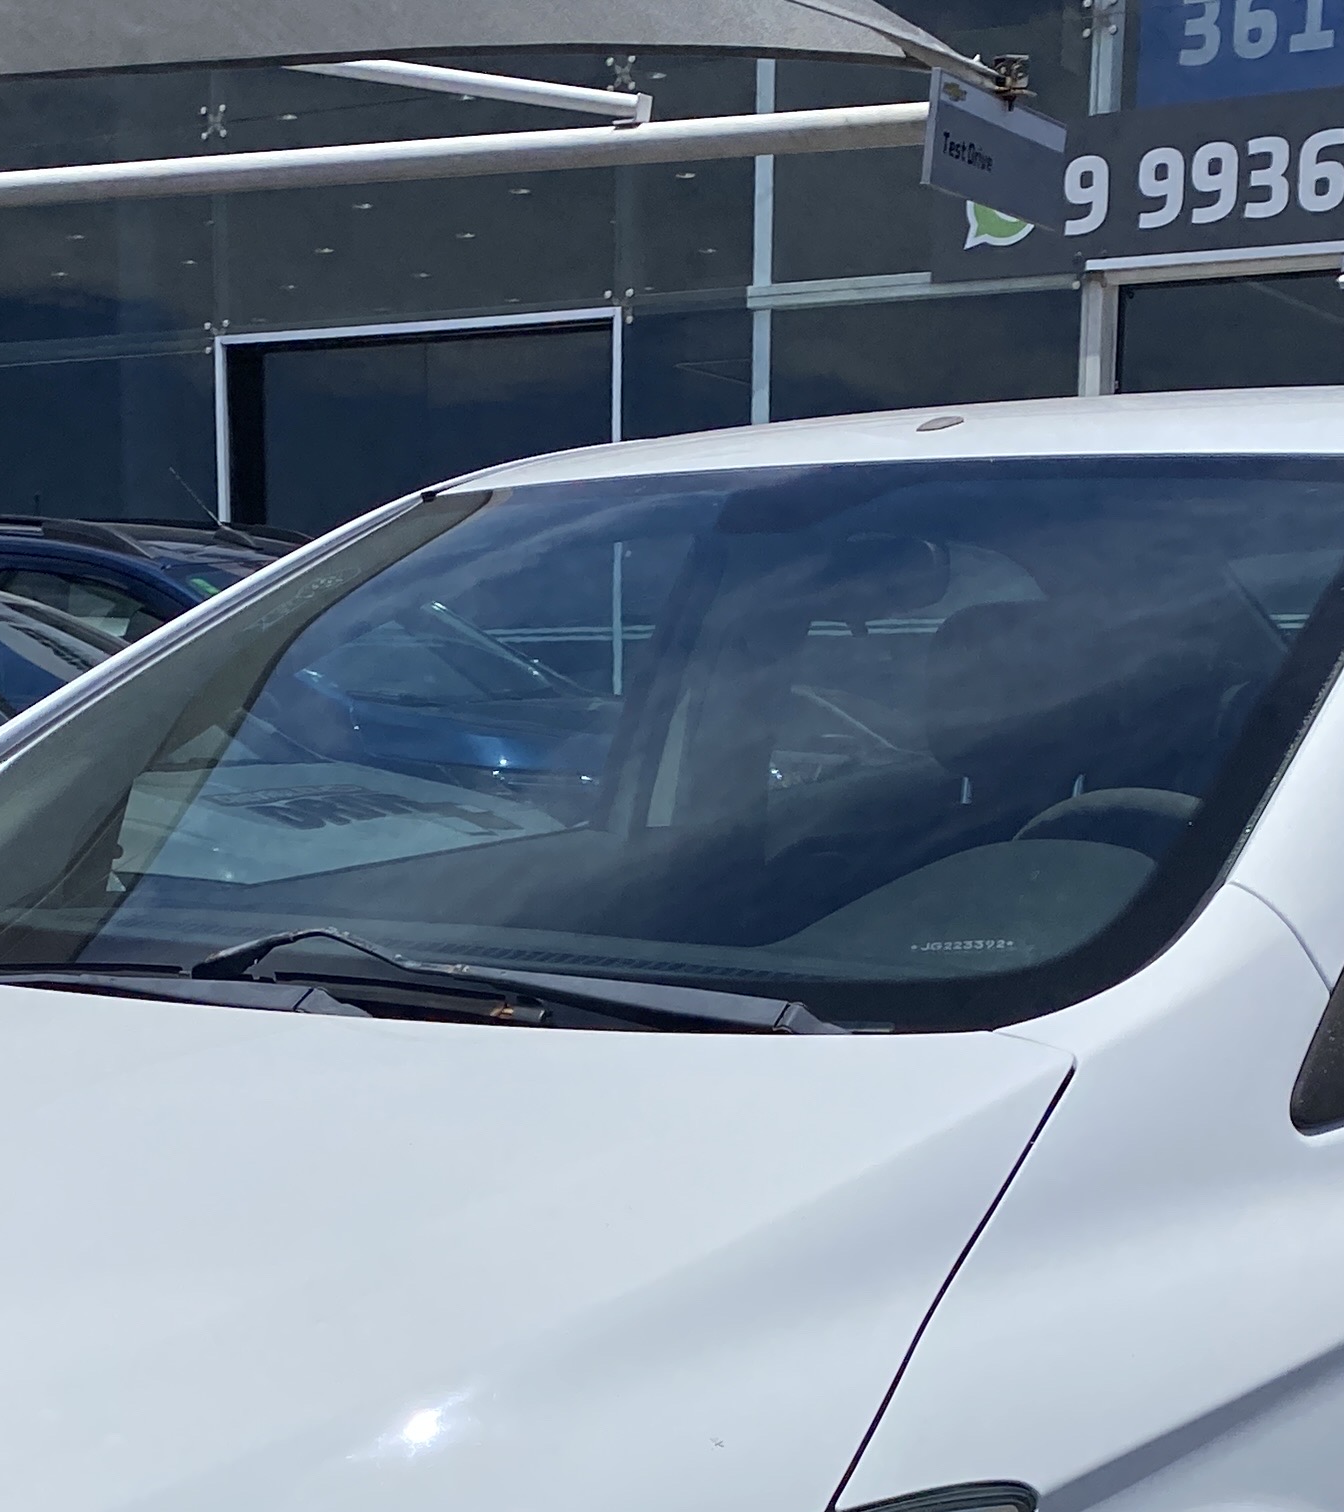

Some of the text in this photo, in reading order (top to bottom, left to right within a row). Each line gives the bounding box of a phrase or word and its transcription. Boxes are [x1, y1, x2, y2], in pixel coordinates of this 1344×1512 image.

[943, 132, 993, 171] Test Drive
[1064, 154, 1109, 237] 9
